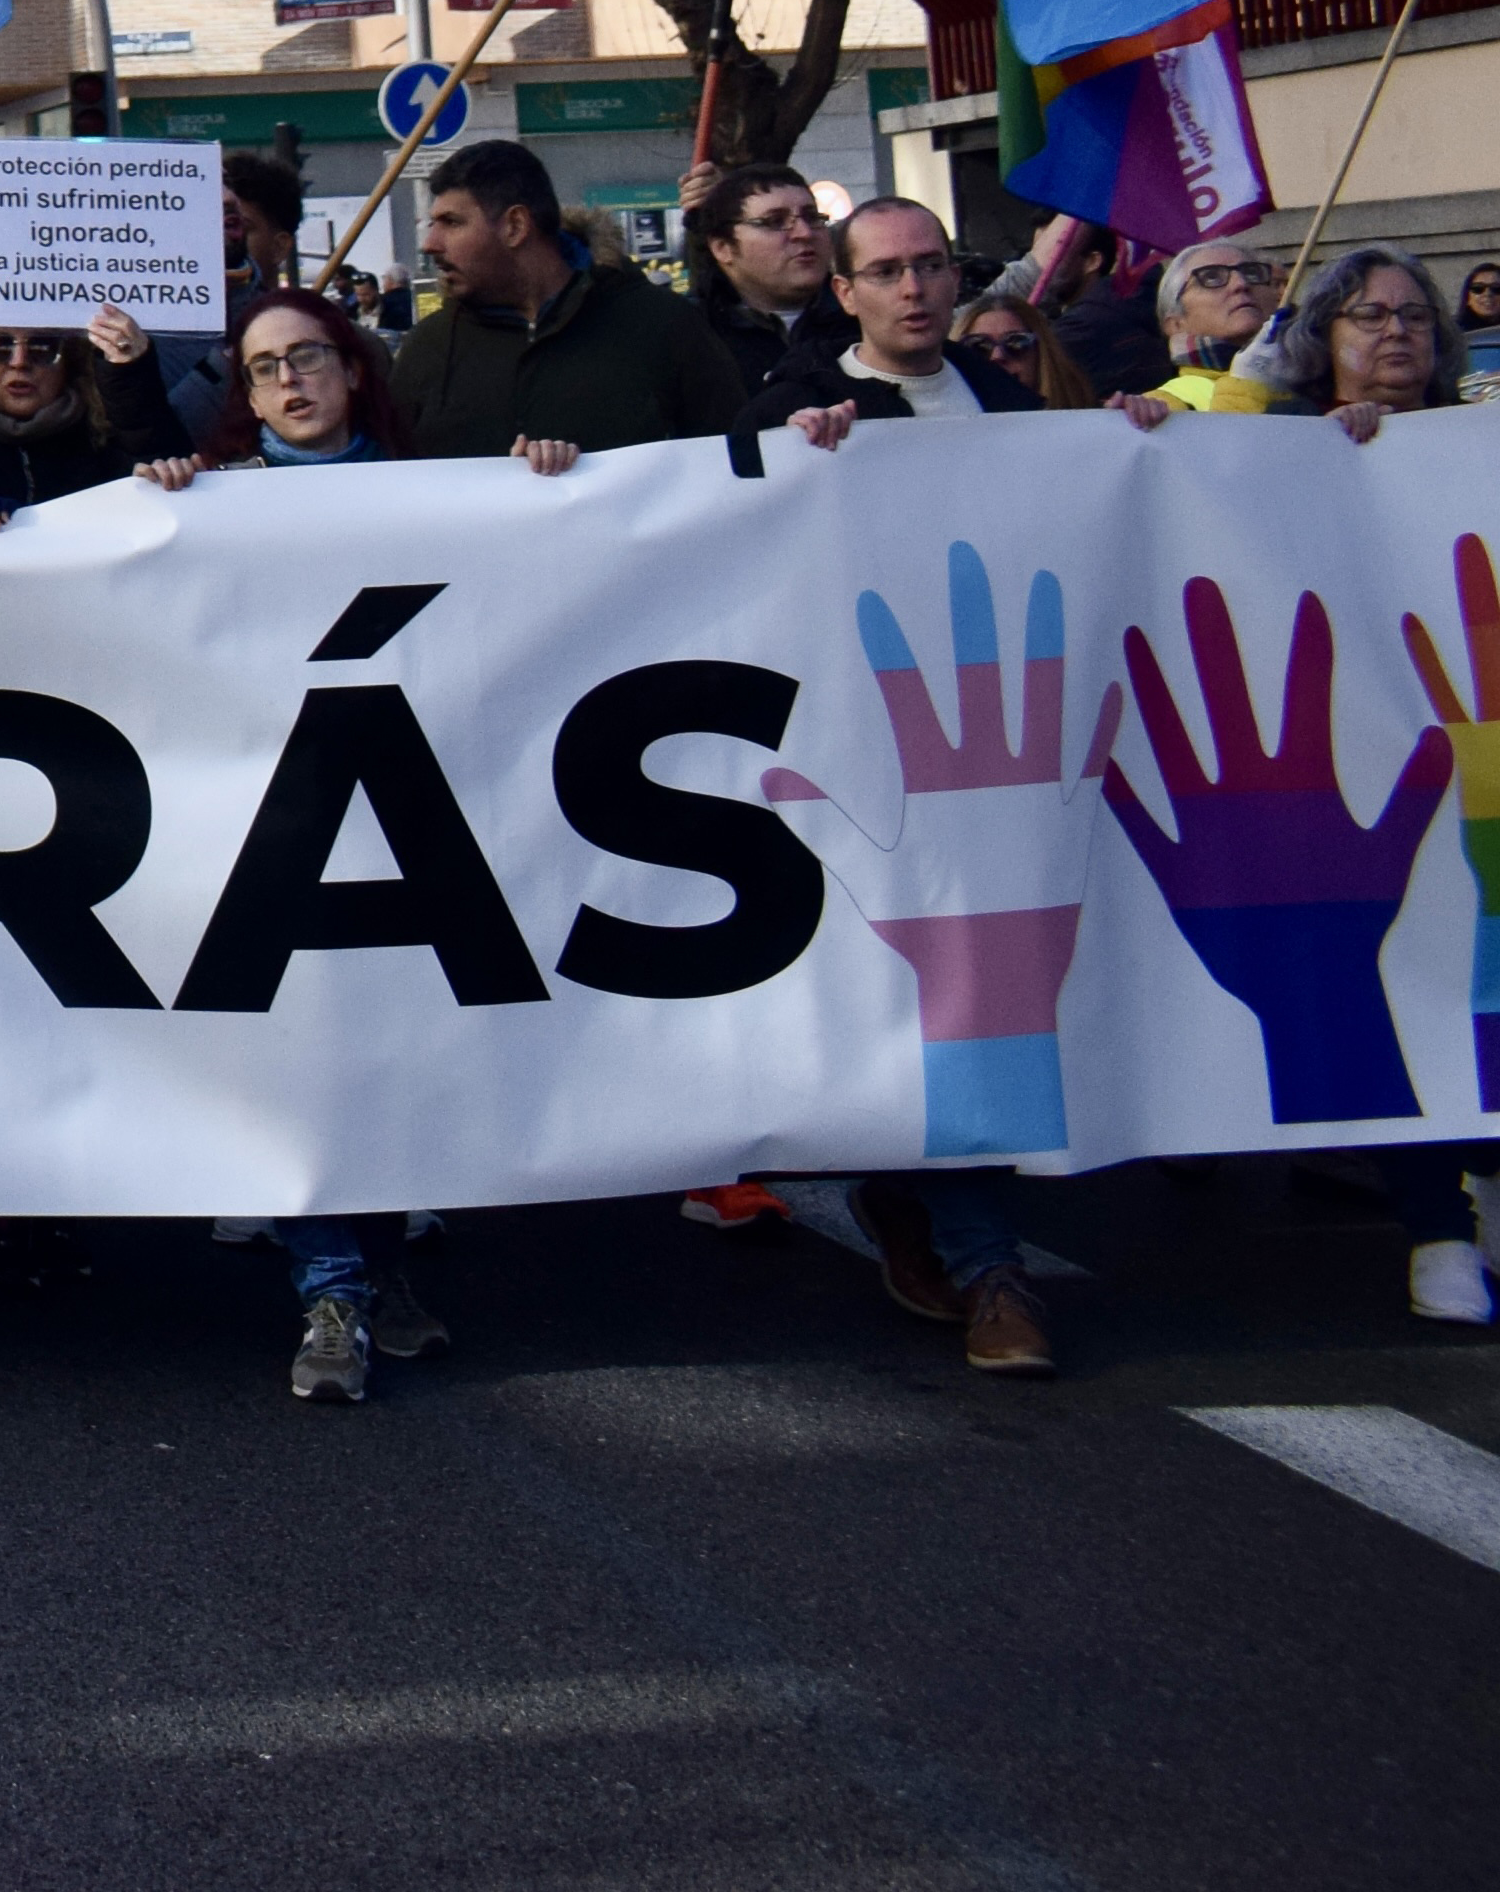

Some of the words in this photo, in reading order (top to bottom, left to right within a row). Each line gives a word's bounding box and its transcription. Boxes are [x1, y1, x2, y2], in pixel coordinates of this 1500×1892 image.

[109, 159, 206, 181] perdida,
[0, 187, 28, 207] mi
[37, 188, 185, 211] sufrimiento
[31, 221, 155, 247] ignorado,
[13, 252, 99, 275] justicia
[106, 255, 199, 274] ausente
